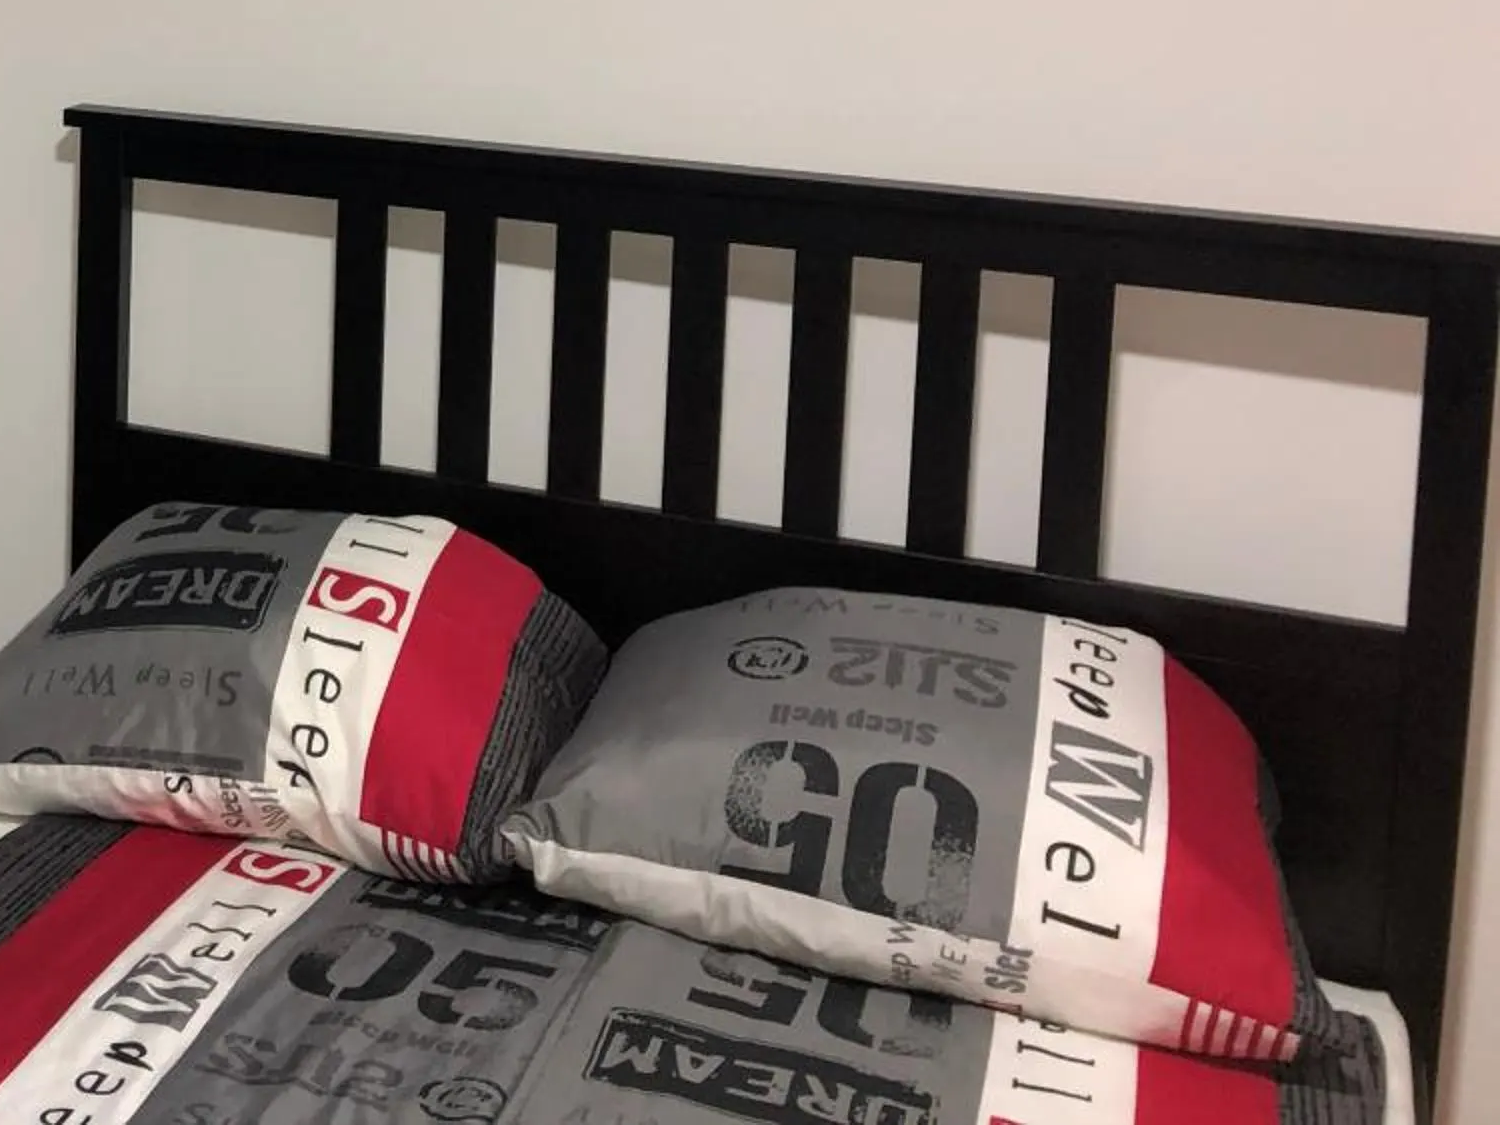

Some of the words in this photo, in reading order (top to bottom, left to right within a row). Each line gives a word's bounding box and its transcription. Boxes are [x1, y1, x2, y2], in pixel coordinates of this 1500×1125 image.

[64, 563, 280, 613] DREAM
[19, 664, 118, 700] Well
[136, 668, 242, 707] Sleep
[768, 702, 839, 730] Well
[845, 708, 939, 746] Sleep
[287, 922, 556, 1033] 05
